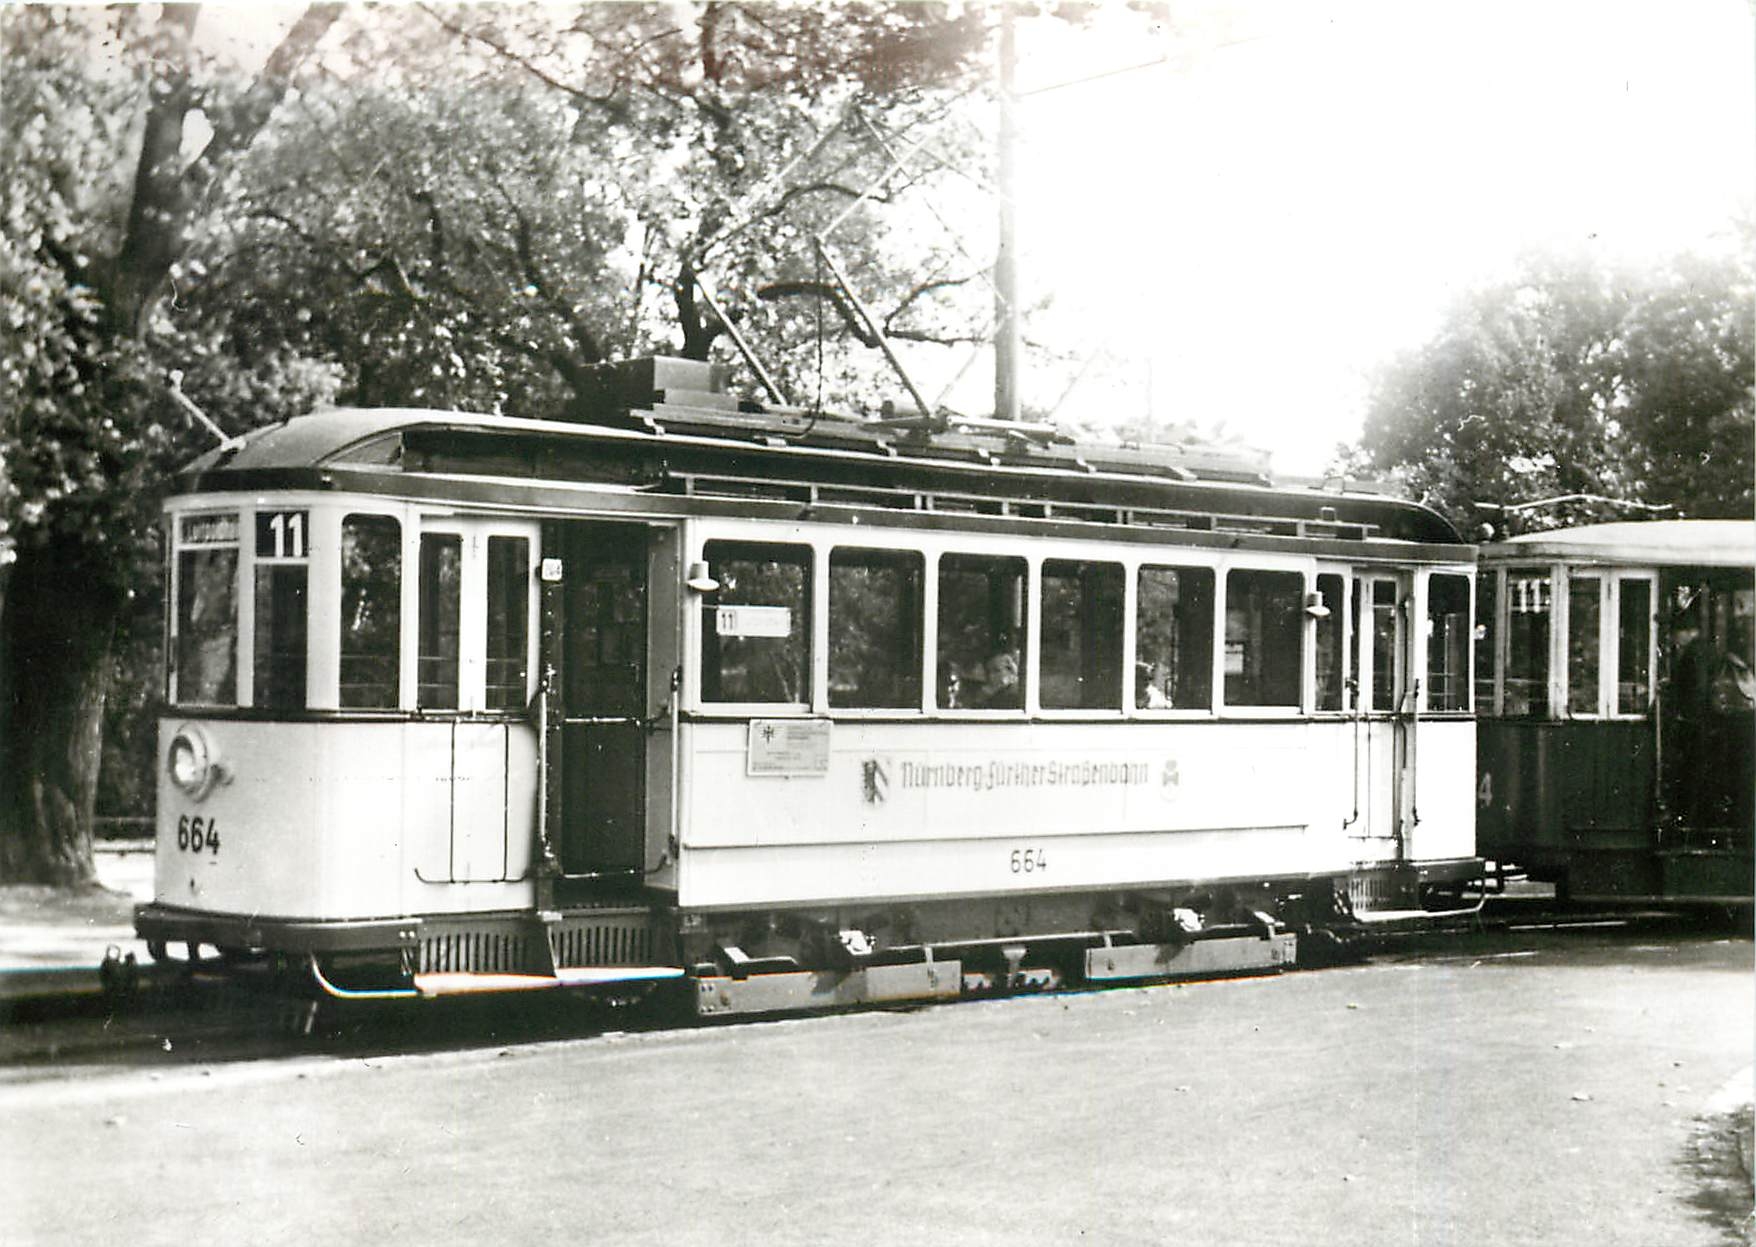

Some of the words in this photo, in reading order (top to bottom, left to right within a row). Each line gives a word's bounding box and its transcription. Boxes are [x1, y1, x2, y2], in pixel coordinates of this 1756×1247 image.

[270, 513, 303, 557] 11
[721, 613, 733, 631] 11
[1047, 760, 1148, 786] Straßenbahn
[179, 815, 220, 855] 664
[1010, 850, 1047, 873] 664
